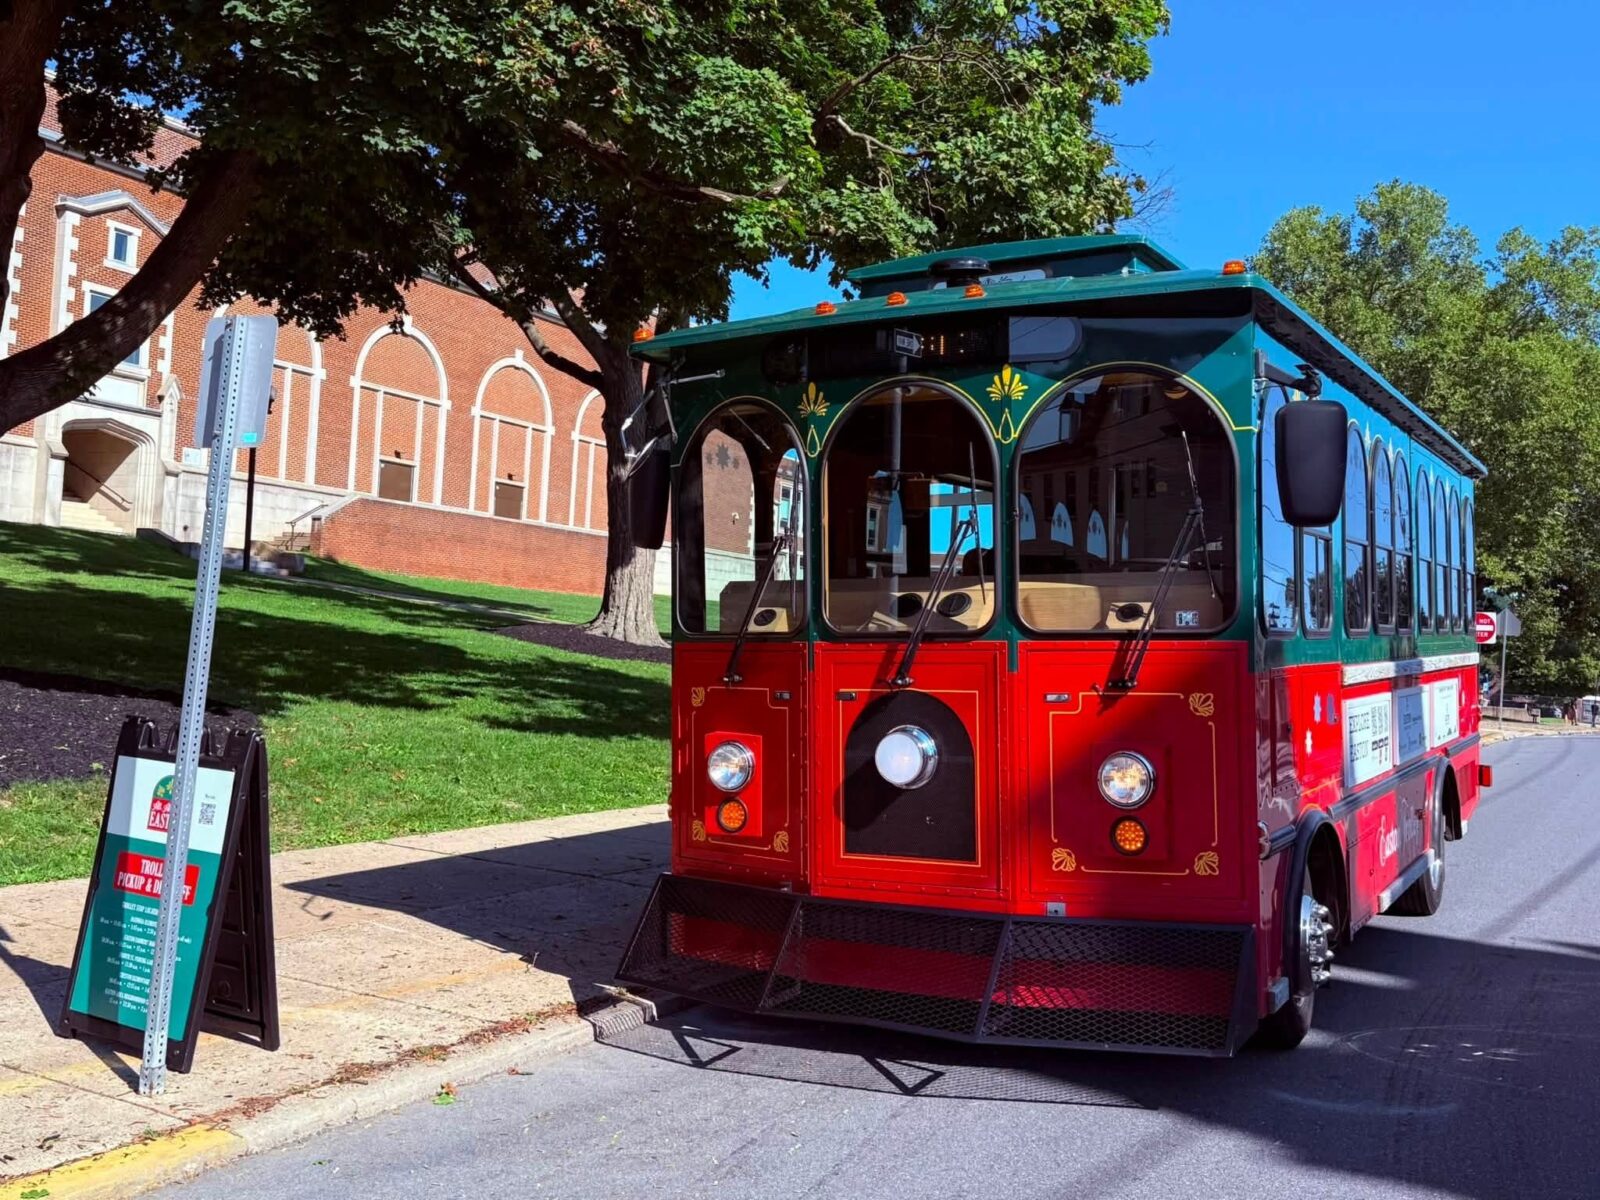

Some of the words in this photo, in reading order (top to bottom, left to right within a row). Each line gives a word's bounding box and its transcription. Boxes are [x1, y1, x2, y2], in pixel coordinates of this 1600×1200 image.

[148, 811, 171, 830] EAST
[141, 859, 164, 877] TROLL
[117, 871, 146, 891] PICKUP
[145, 878, 153, 893] &
